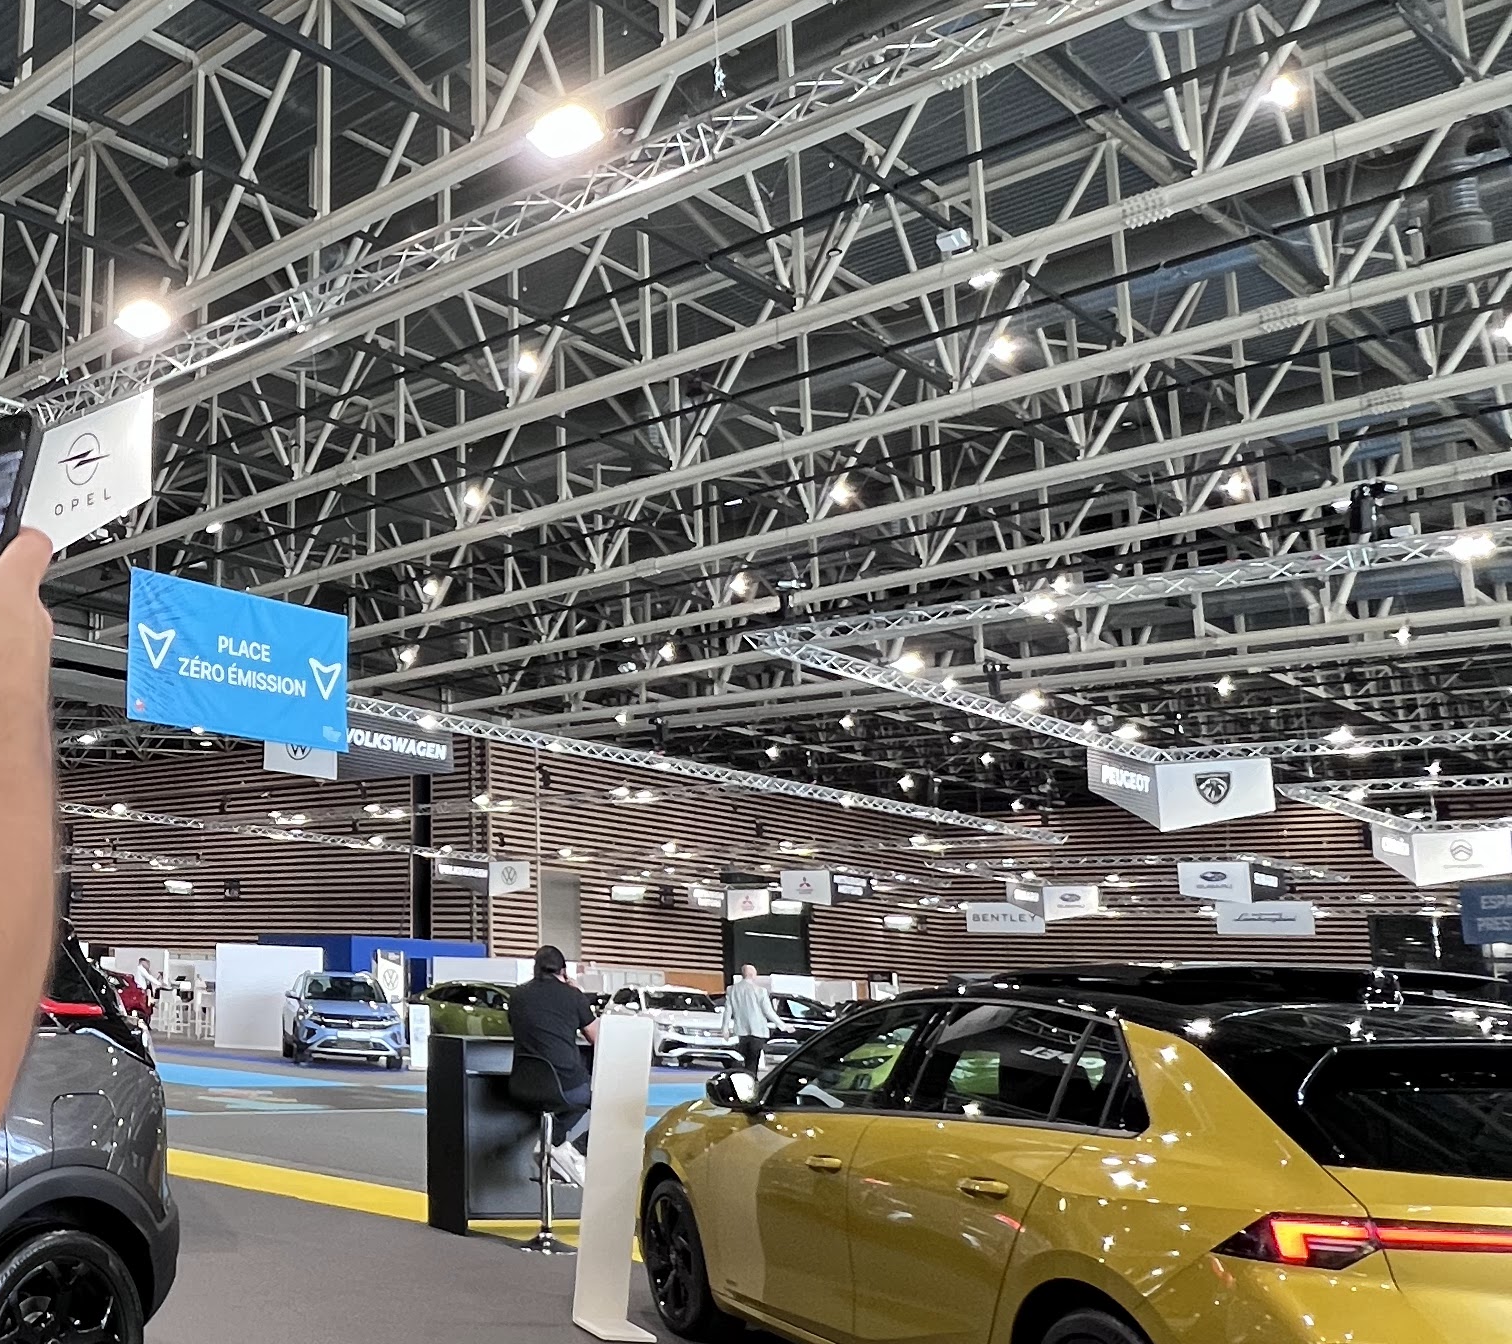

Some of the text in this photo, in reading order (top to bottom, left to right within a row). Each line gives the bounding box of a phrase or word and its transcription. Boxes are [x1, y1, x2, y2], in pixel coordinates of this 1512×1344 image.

[55, 488, 111, 516] OPEL
[218, 635, 271, 663] PLACE
[178, 655, 306, 698] ZÉRO ÉMISSION
[346, 727, 447, 760] VOLKSWAGEN
[1101, 764, 1151, 793] PEUGEOT
[972, 913, 1036, 924] BENTLEY
